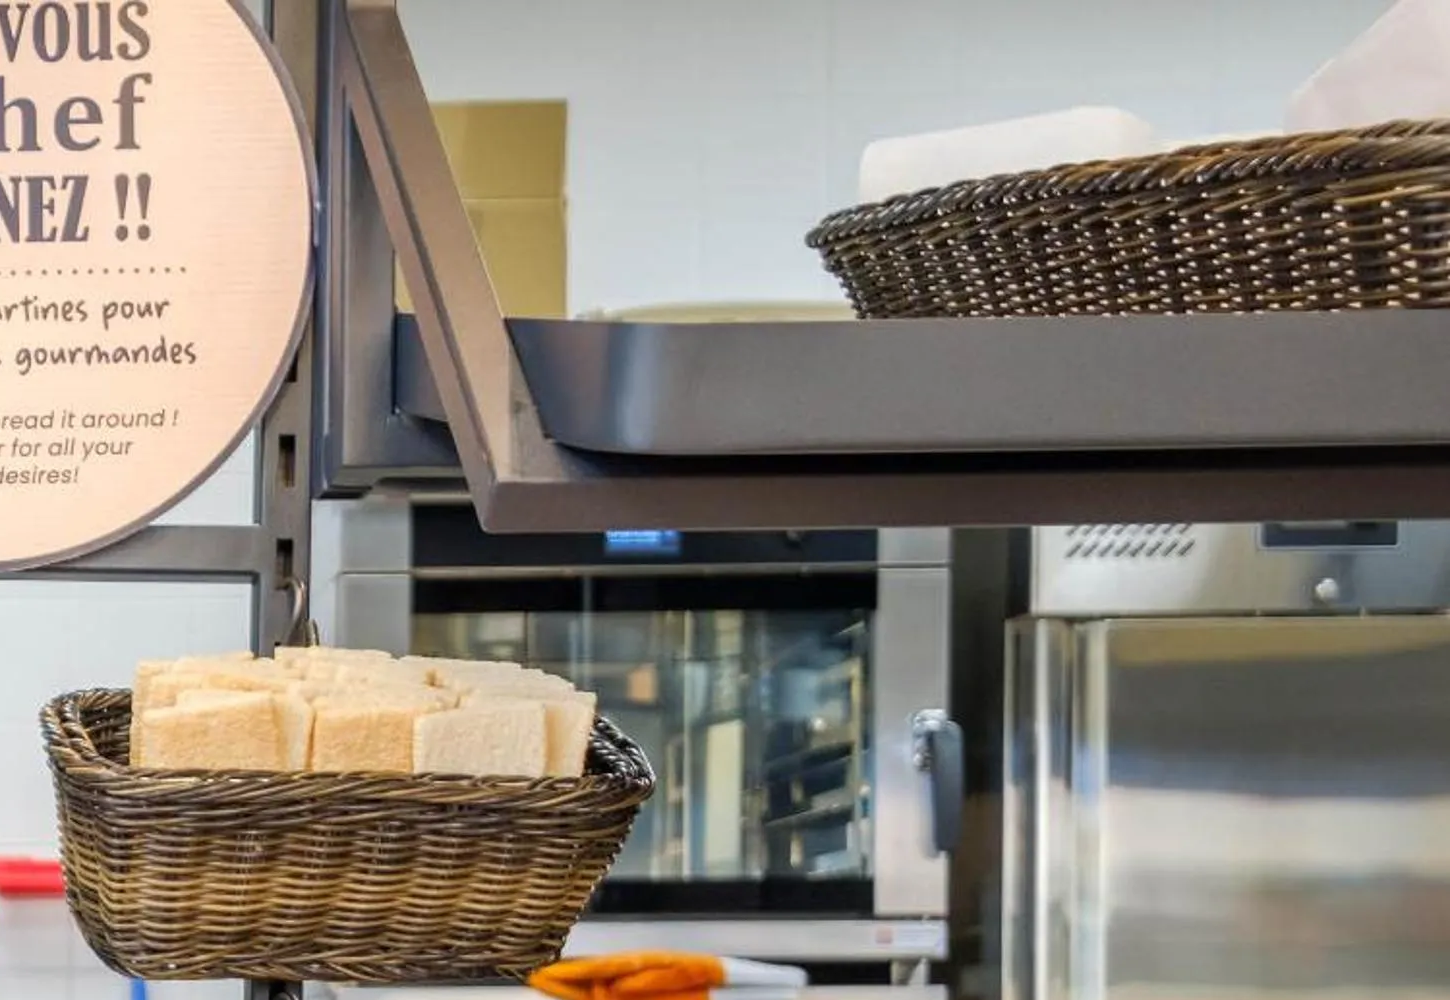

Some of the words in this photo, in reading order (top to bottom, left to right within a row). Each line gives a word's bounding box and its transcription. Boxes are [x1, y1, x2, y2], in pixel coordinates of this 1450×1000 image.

[114, 172, 152, 242] !!
[102, 300, 170, 330] pour
[15, 335, 197, 376] gourmandes
[61, 409, 76, 429] it
[81, 408, 166, 429] around
[11, 437, 43, 458] for
[47, 437, 76, 457] all
[82, 441, 133, 462] your
